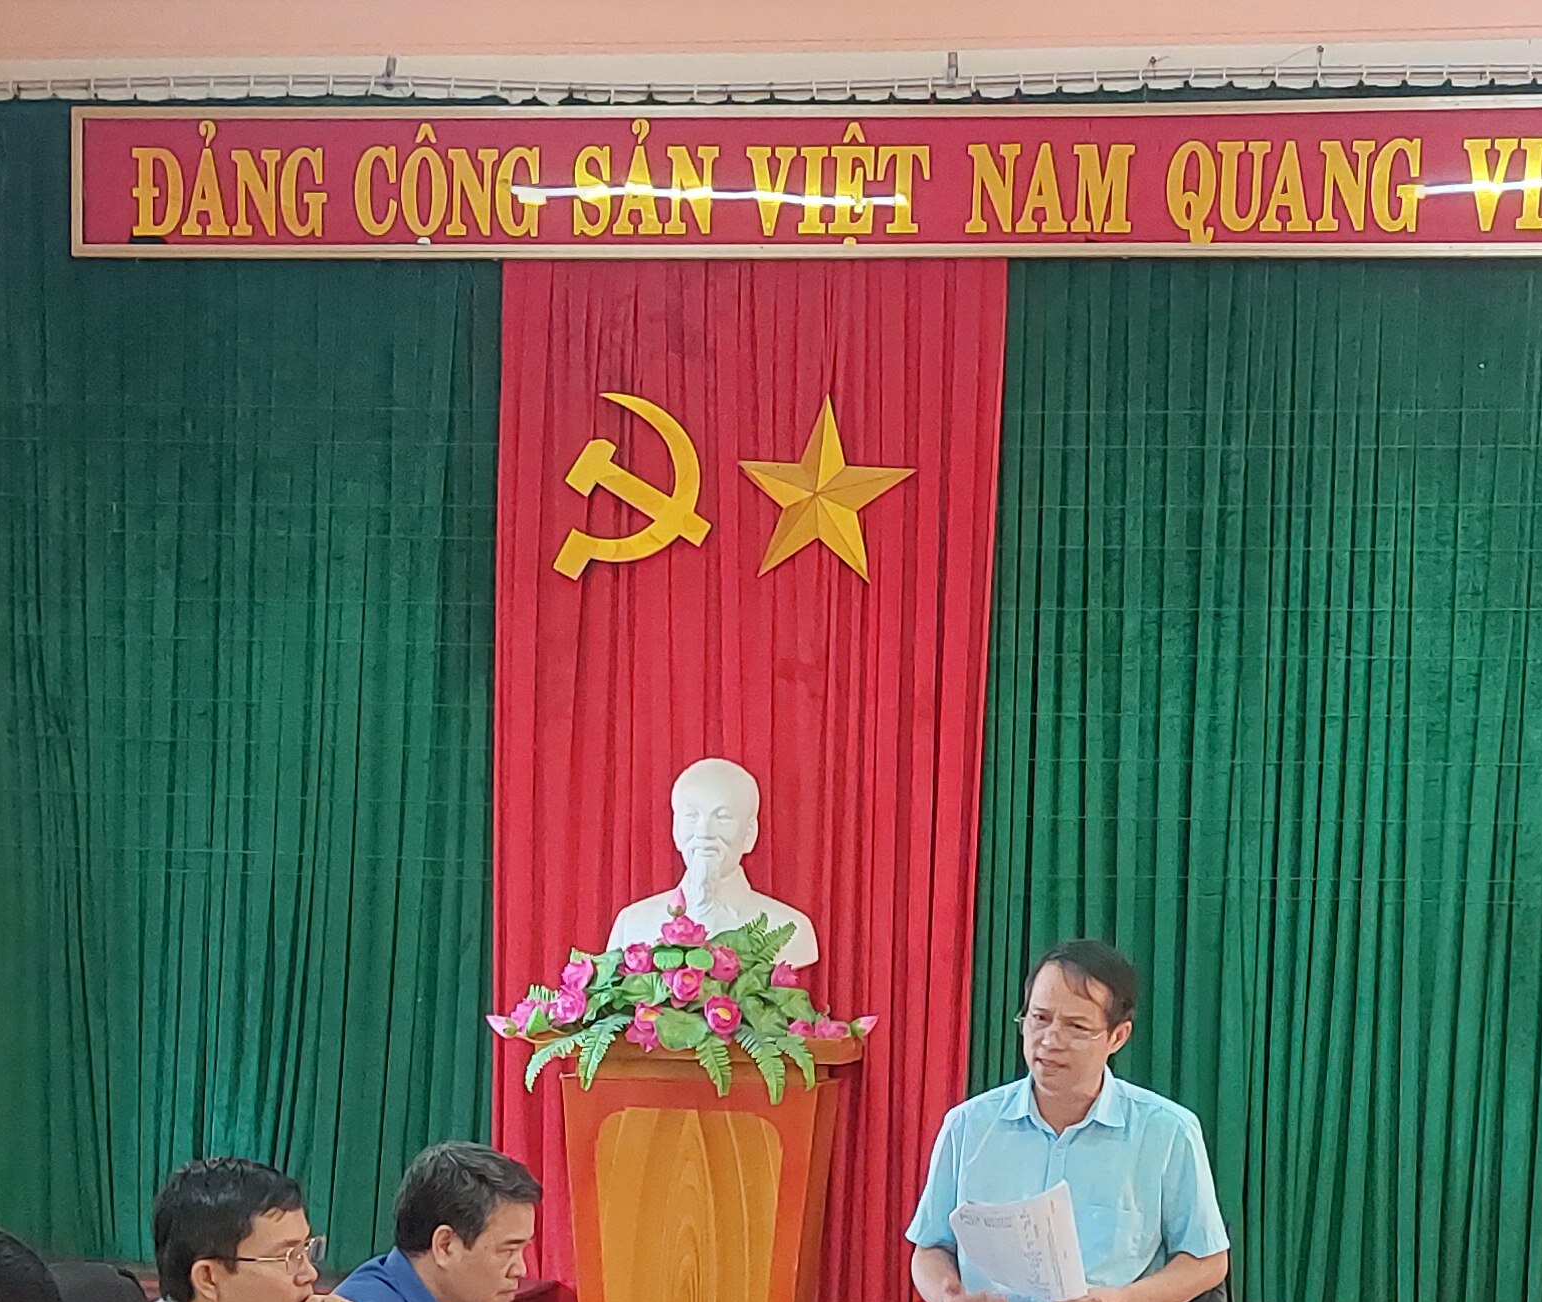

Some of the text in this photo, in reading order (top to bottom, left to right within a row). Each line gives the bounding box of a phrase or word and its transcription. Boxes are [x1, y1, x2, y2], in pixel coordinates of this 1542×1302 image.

[132, 120, 327, 237] ĐẢNG
[354, 122, 542, 245] CỘNG
[573, 119, 720, 237] SẢN
[746, 122, 931, 245] VIỆT
[964, 142, 1136, 234] NAM
[1166, 138, 1424, 245] QUANG
